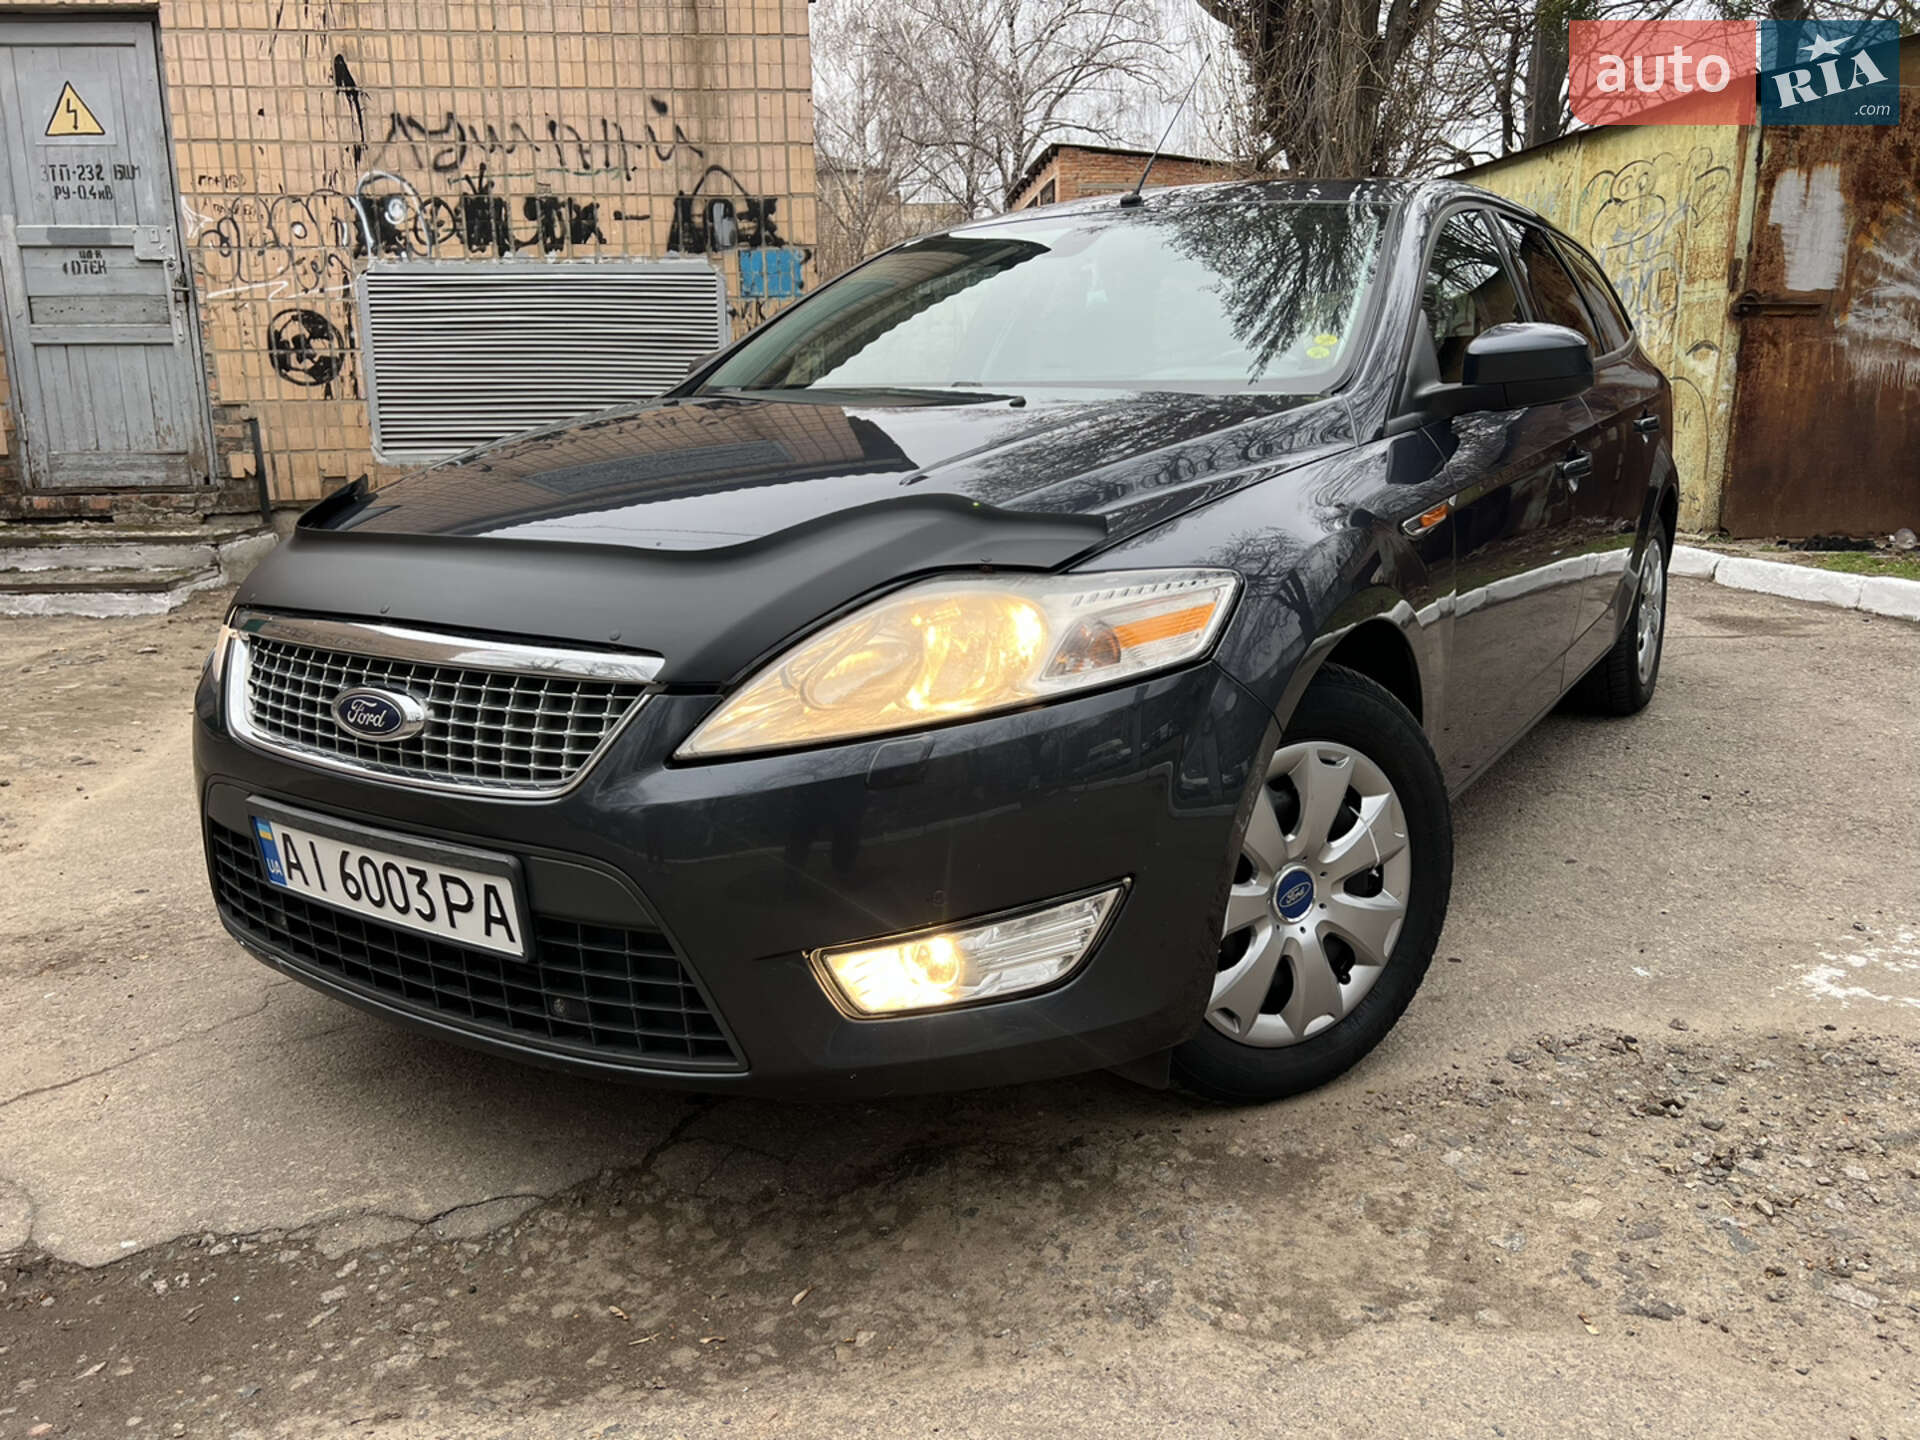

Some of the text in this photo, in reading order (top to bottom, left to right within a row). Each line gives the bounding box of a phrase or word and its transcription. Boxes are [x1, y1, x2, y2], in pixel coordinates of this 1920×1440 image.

[347, 698, 388, 728] Ford
[267, 858, 283, 876] UA
[281, 832, 327, 892] AI
